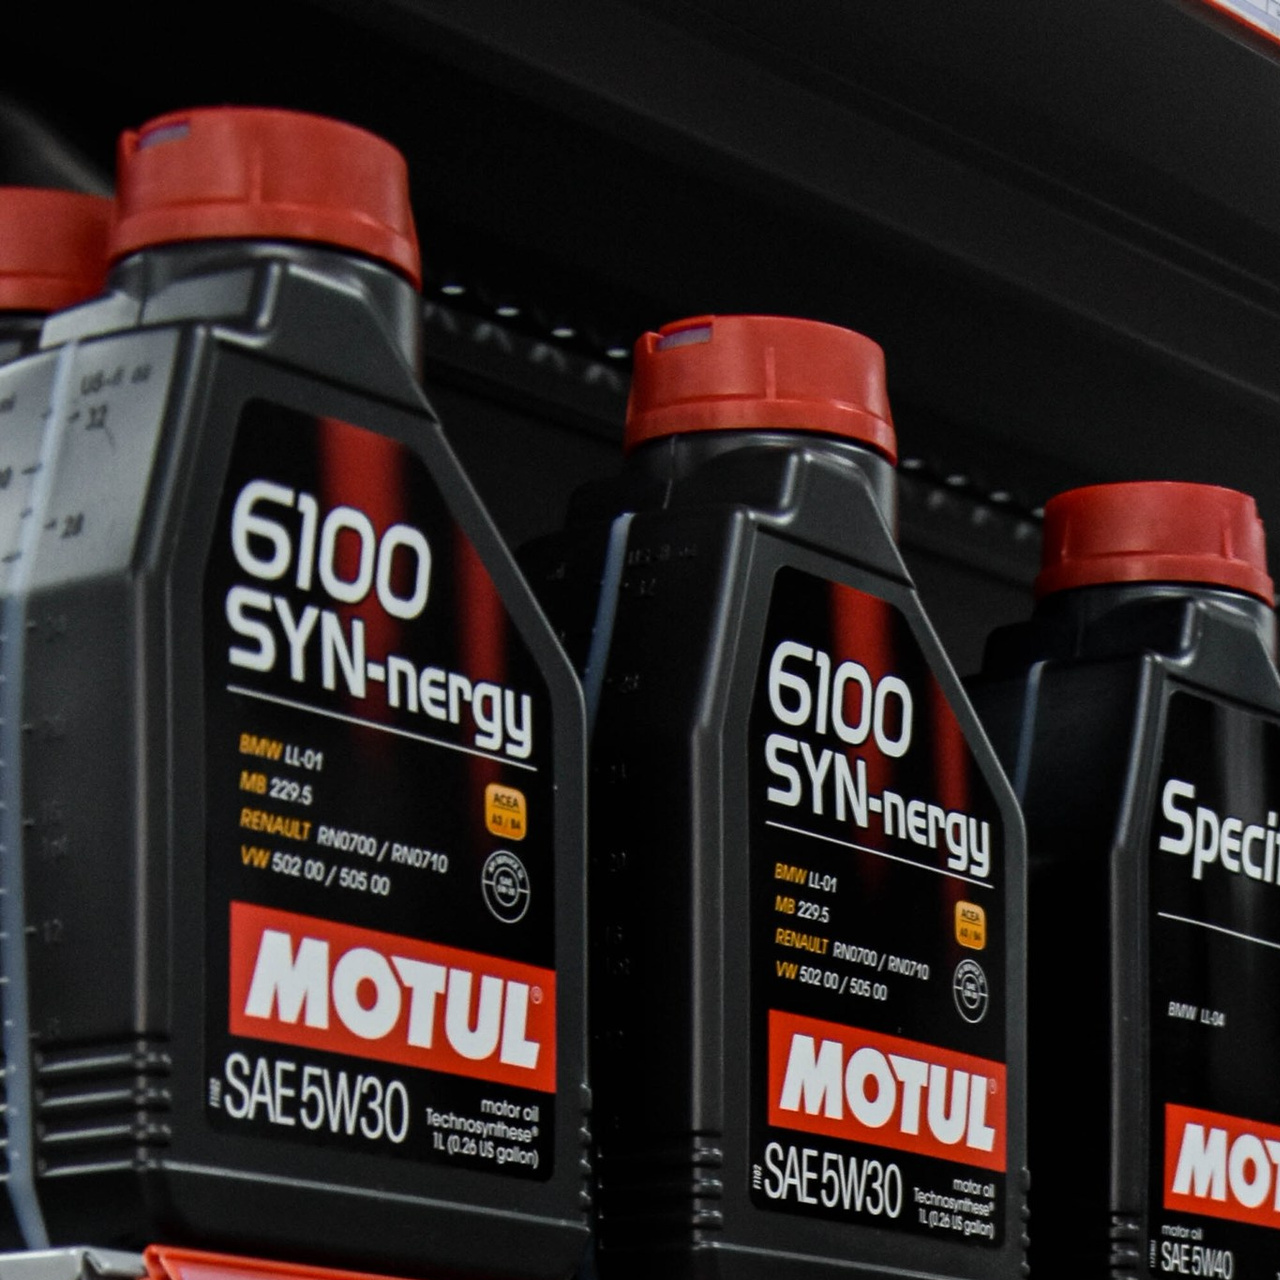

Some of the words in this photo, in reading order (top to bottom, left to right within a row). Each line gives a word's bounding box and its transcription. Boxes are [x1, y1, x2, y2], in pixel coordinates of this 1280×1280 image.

[231, 479, 432, 619] 6100
[225, 585, 532, 758] SYN-nergy
[769, 641, 913, 758] 6100
[239, 733, 283, 761] BMW
[284, 743, 324, 771] LL-01
[239, 770, 267, 794] MB
[269, 778, 313, 805] 229.5
[765, 733, 990, 878] SYN-nergy
[240, 808, 311, 841] RENAULT
[317, 826, 377, 857] RN0700
[390, 843, 449, 873] RN0710
[241, 845, 271, 869] VW
[272, 855, 302, 878] 502
[304, 861, 325, 882] 00
[339, 871, 365, 891] 505
[368, 874, 390, 895] 00
[774, 862, 807, 885] BMW
[808, 871, 837, 893] LL-01
[775, 895, 795, 915] MB
[797, 901, 829, 924] 229.5
[775, 928, 829, 956] RENAULT
[833, 942, 877, 967] RN0700
[887, 957, 929, 981] RN0710
[776, 961, 797, 980] VW
[799, 967, 821, 985] 502
[850, 978, 869, 997] 505
[244, 929, 540, 1069] MOTUL
[1168, 1001, 1197, 1021] BMW
[481, 1099, 519, 1120] motor
[523, 1103, 539, 1123] oil
[780, 1033, 995, 1152] MOTUL
[479, 1138, 494, 1158] US
[496, 1143, 539, 1169] gallon)
[953, 1178, 980, 1194] motor
[1161, 1241, 1190, 1274] SAE
[1192, 1248, 1234, 1280] 5W40
